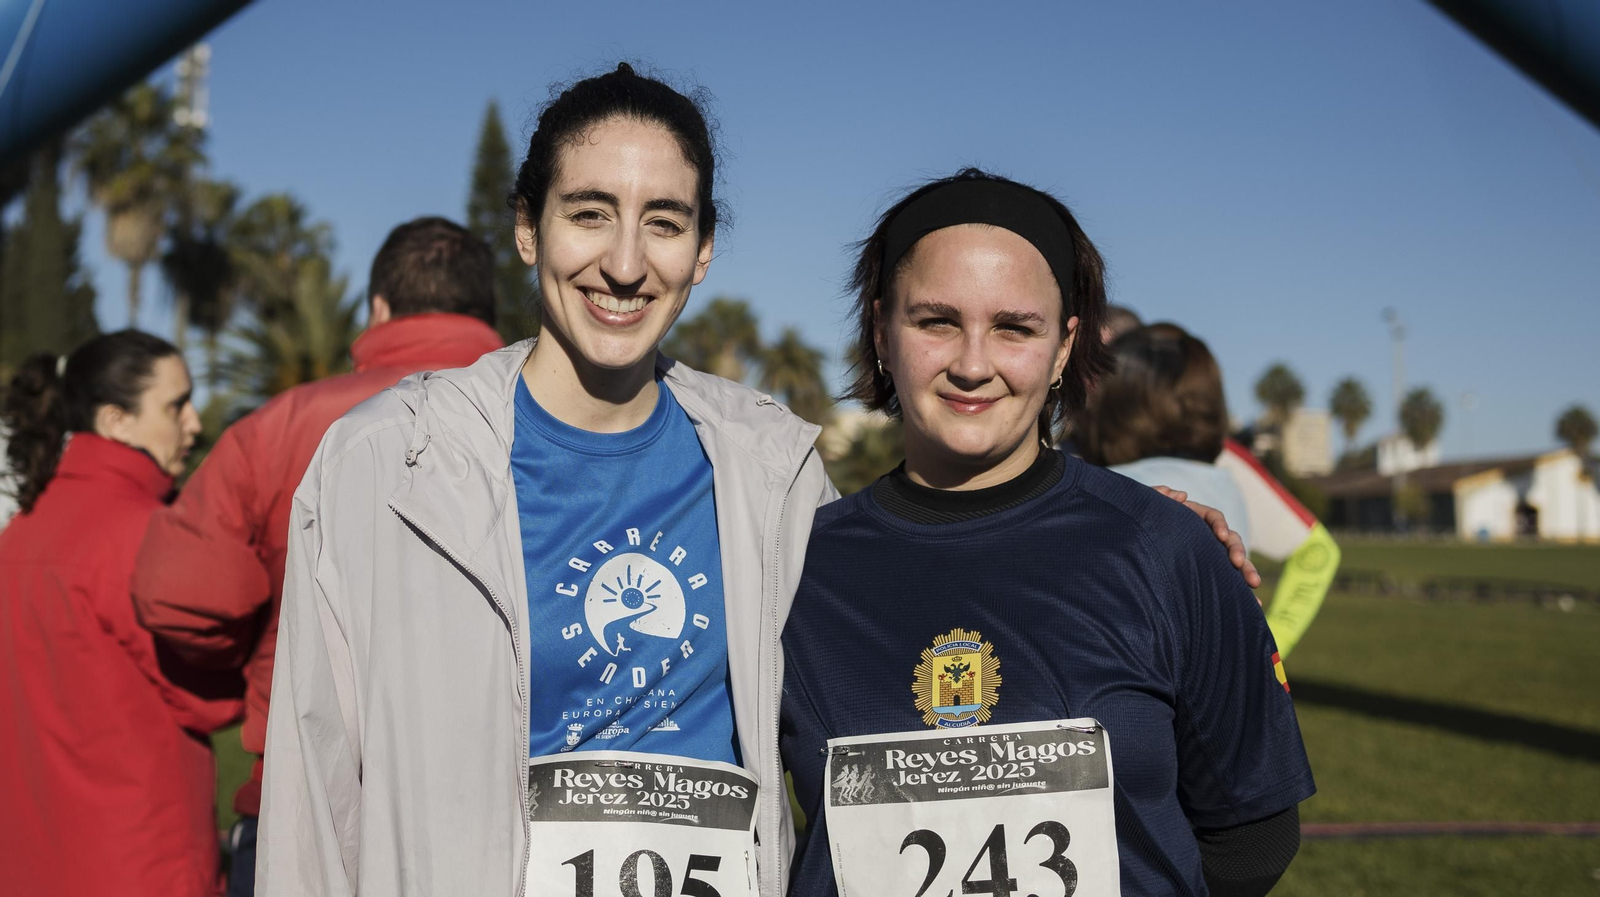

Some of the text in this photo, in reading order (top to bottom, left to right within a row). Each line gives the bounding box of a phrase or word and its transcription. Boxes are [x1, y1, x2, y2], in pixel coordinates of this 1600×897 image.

[555, 527, 708, 597] CARRERA
[561, 613, 710, 688] SENDERO
[935, 642, 958, 653] POLICIA
[586, 698, 604, 706] EN
[943, 720, 971, 728] ALCUDIA
[943, 733, 1022, 746] CARRERA
[614, 761, 684, 773] CRRERA
[885, 740, 1097, 772] Reyes Magos
[552, 768, 749, 800] Reyes Magos
[893, 761, 1036, 786] Jerez 2025
[1011, 780, 1047, 790] juguete
[558, 789, 691, 810] Jerez 2025
[899, 820, 1078, 897] 243
[561, 849, 722, 897] 195
